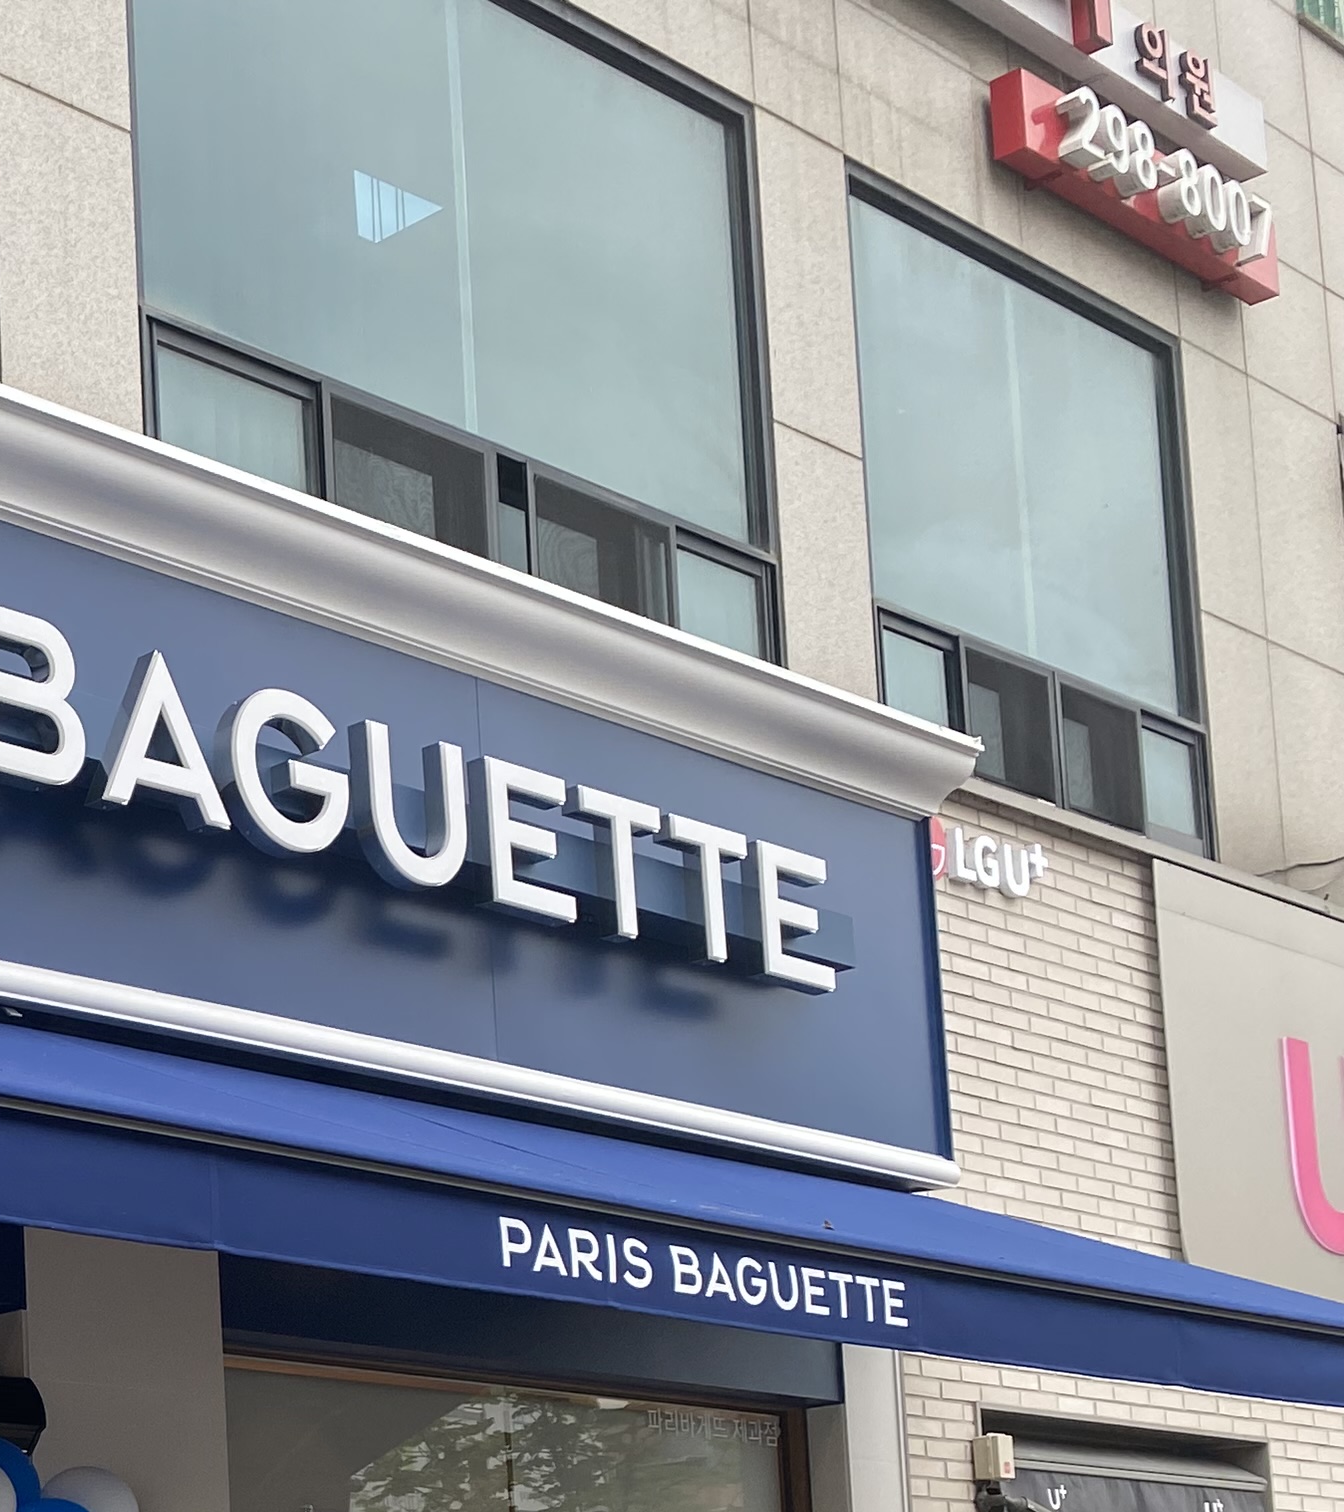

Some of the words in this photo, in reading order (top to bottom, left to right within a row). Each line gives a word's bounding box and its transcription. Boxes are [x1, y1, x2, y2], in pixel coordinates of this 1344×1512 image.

[1134, 22, 1219, 130] 의원
[1055, 85, 1273, 267] 298-8007
[497, 1215, 654, 1290] PARIS
[668, 1243, 910, 1328] BAGUETTE
[646, 1407, 729, 1441] 파리바게뜨
[731, 1418, 782, 1448] 제과점
